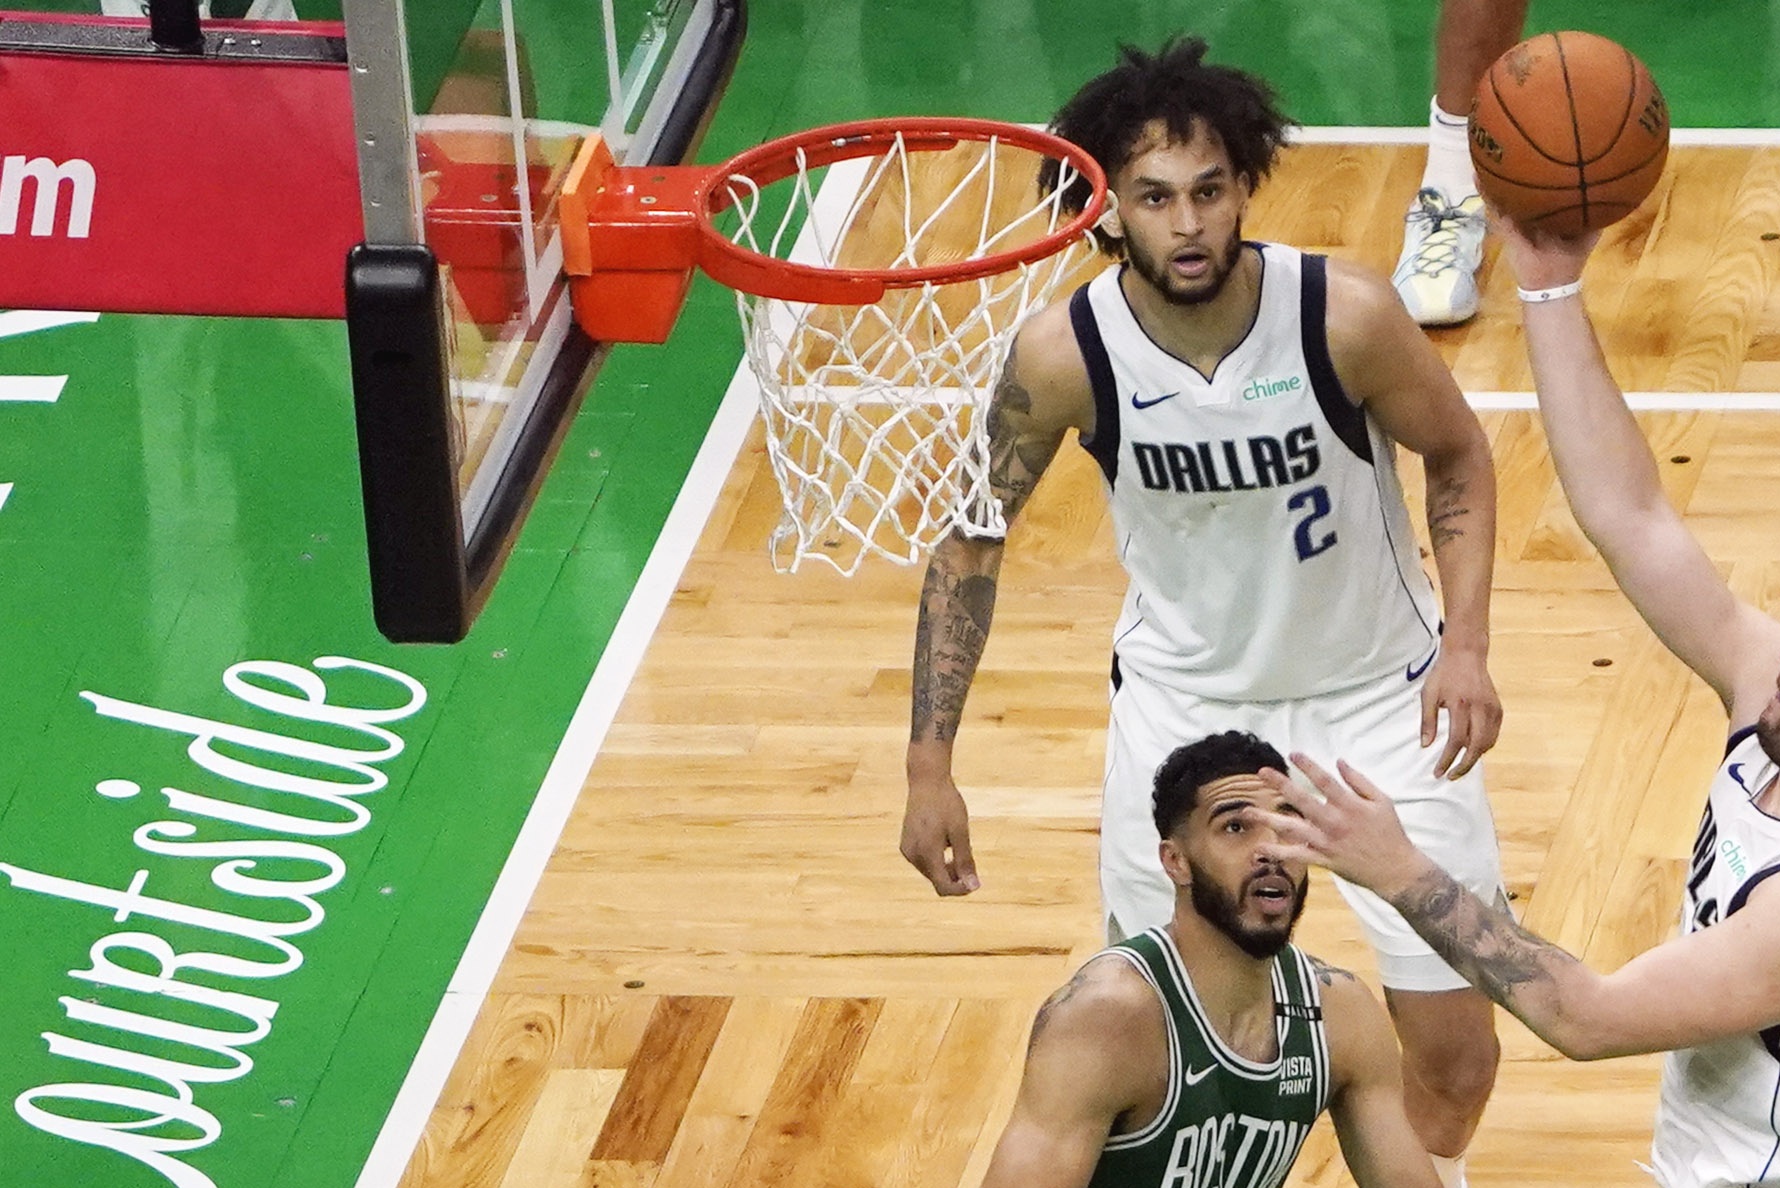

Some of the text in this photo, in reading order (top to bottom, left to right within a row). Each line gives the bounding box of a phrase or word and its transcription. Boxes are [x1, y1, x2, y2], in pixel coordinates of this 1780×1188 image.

[1243, 376, 1301, 401] chime
[1131, 424, 1320, 493] DALLAS
[1287, 485, 1338, 562] 2
[1280, 1056, 1313, 1080] VISTA
[1279, 1078, 1312, 1096] PRINT
